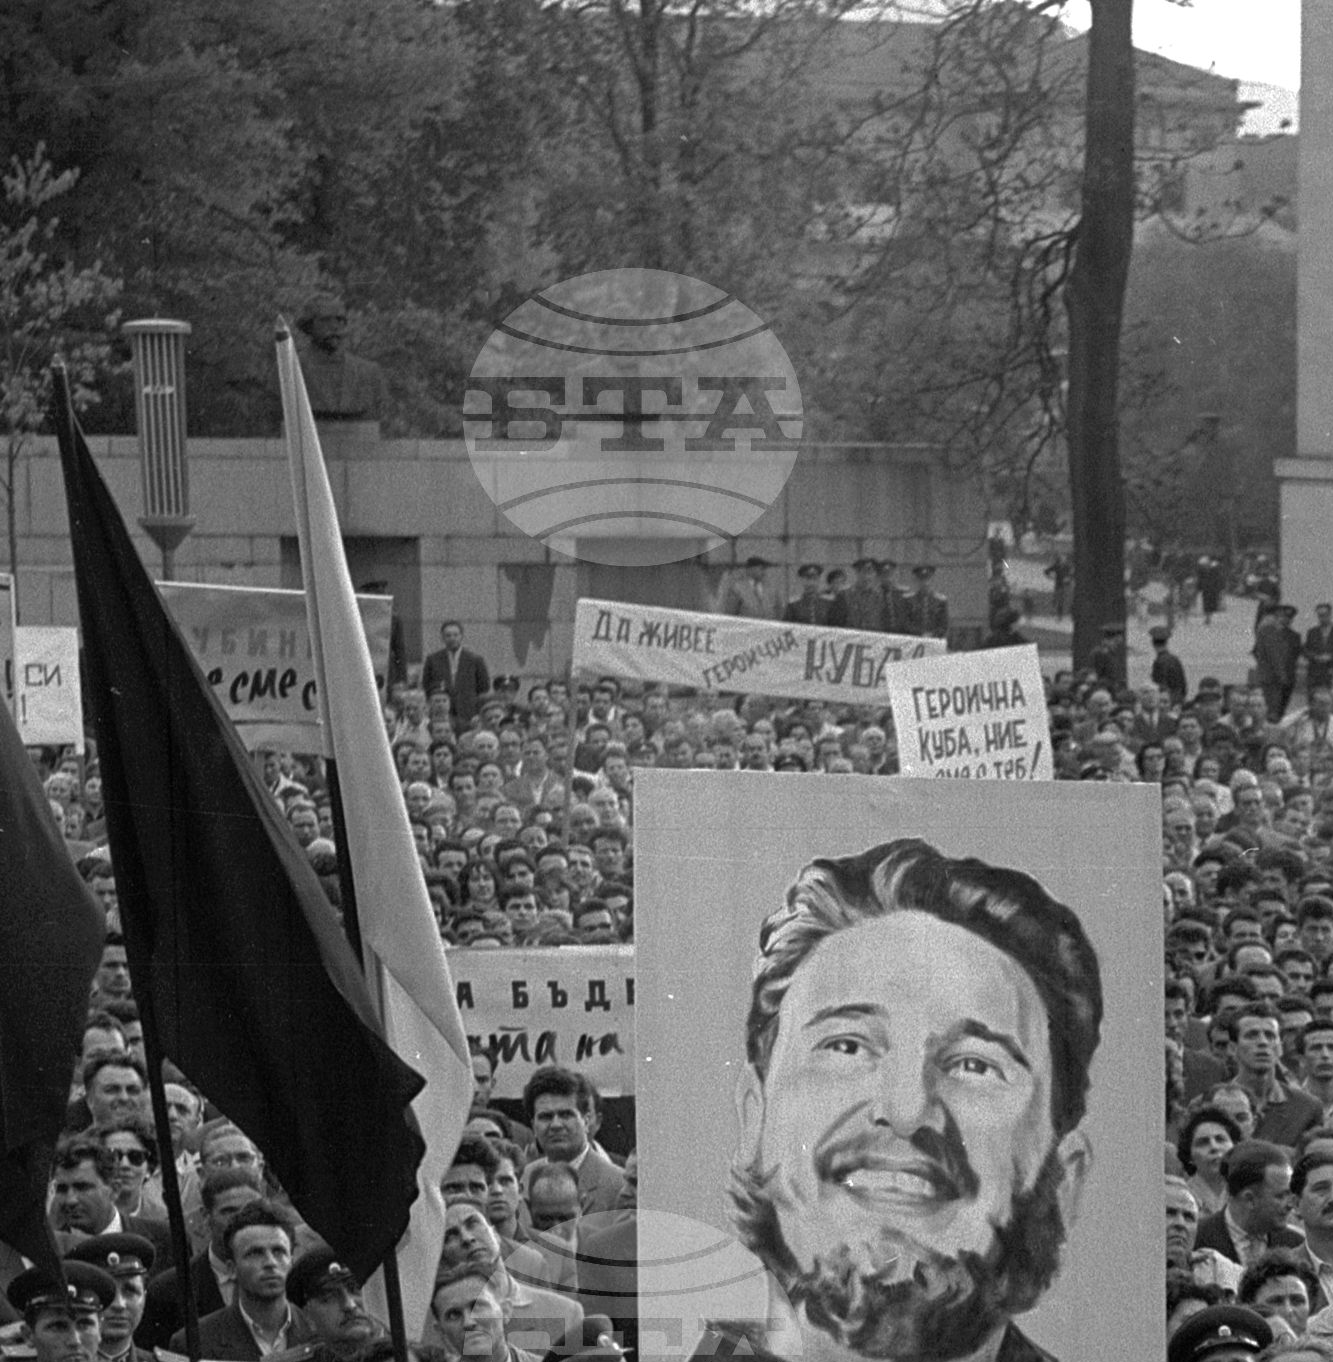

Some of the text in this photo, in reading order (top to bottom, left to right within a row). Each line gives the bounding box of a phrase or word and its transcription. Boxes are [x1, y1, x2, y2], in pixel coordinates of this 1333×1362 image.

[638, 623, 717, 654] ЖИВЕЕ
[701, 630, 797, 688] ГЕРОИЧНА
[911, 679, 1027, 722] ГЕРОИЧНА
[983, 718, 1028, 753] НИЕ
